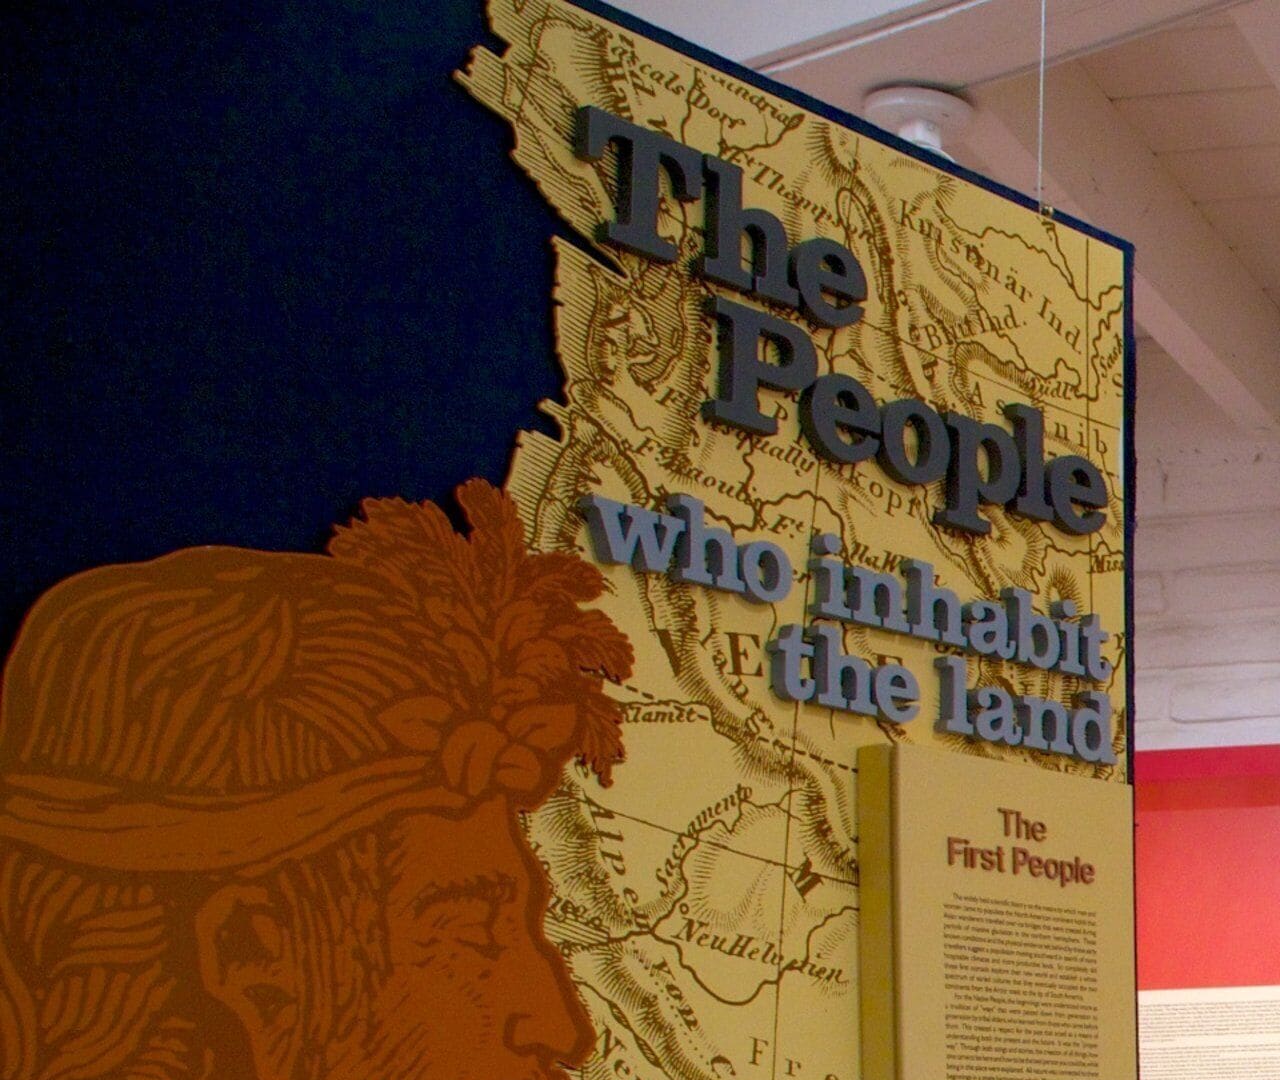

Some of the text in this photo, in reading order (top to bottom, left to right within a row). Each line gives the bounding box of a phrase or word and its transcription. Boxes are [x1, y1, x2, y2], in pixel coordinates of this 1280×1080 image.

[575, 106, 866, 328] The
[703, 299, 1109, 536] People
[586, 494, 1111, 683] who inhabit
[769, 622, 1114, 764] the land
[946, 836, 1097, 887] First People
[998, 807, 1048, 843] The
